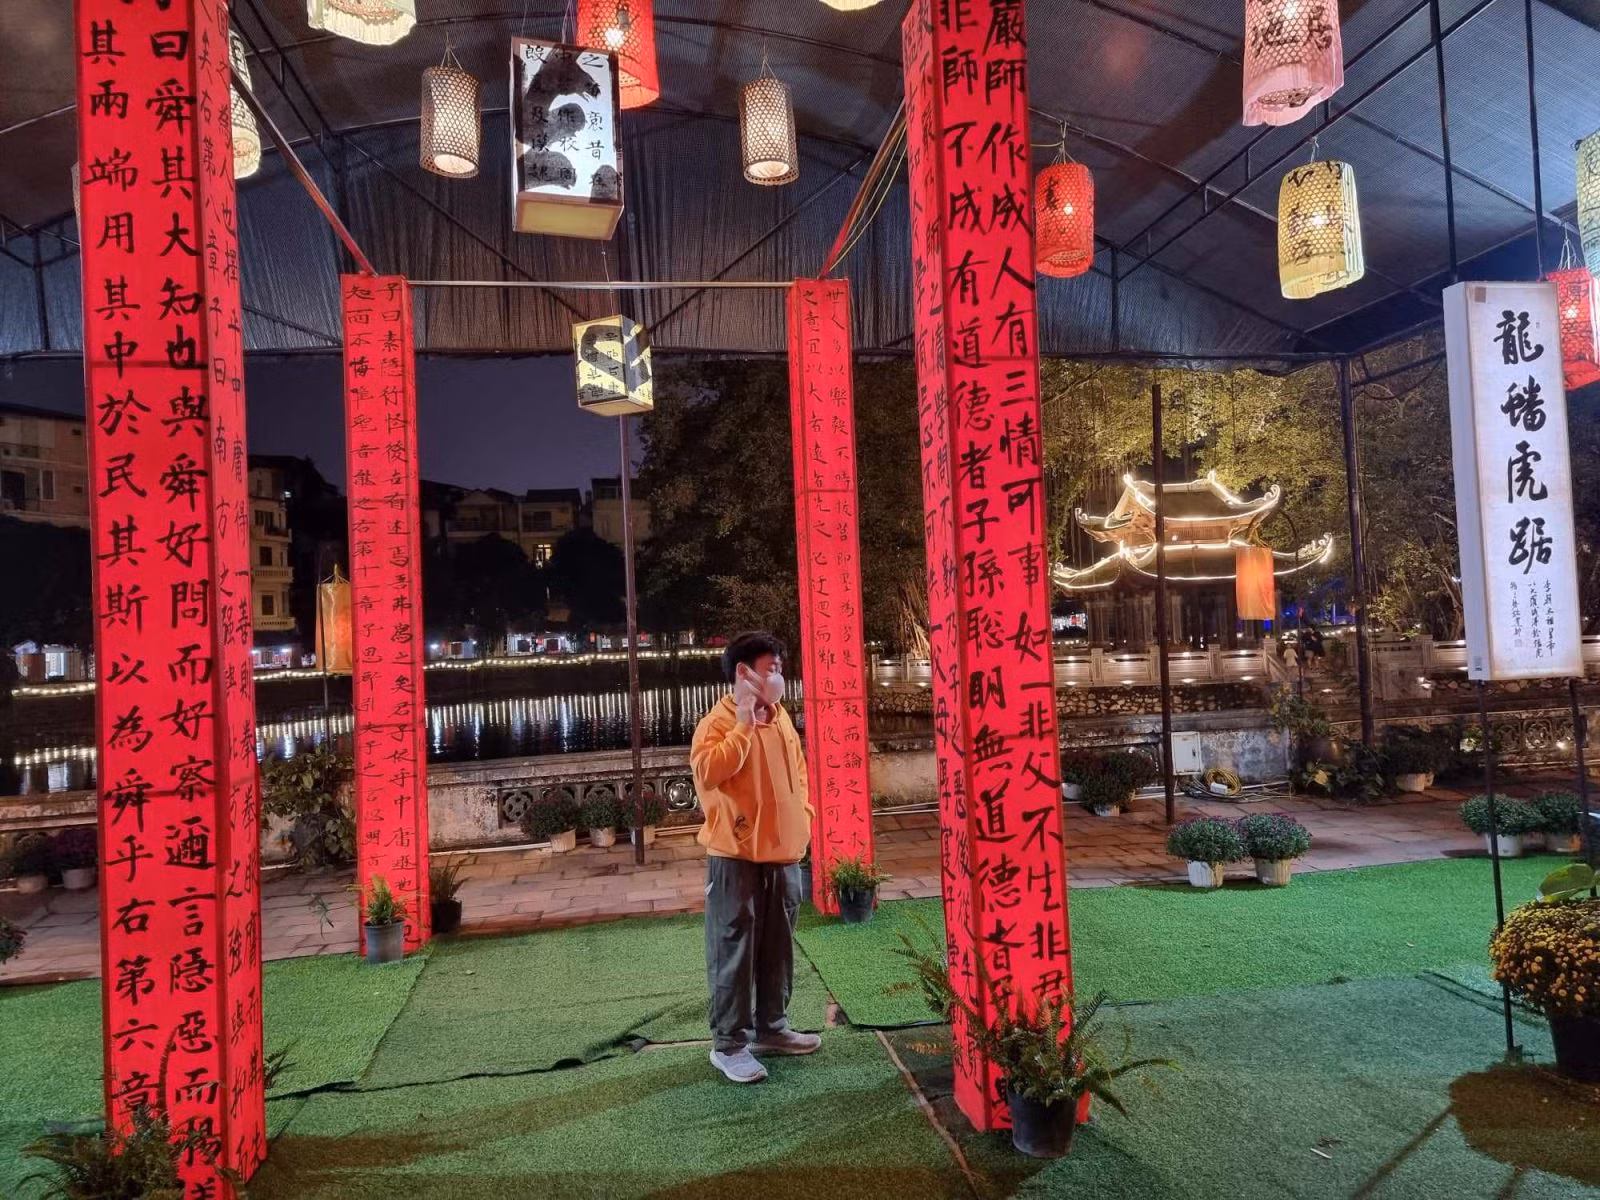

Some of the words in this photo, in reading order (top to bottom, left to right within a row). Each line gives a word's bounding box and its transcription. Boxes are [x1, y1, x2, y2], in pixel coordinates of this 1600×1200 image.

[83, 0, 160, 1115] 其兩端用其中於民其斯以為舜乎右第六章
[1493, 309, 1554, 575] 龍蟠虎踞
